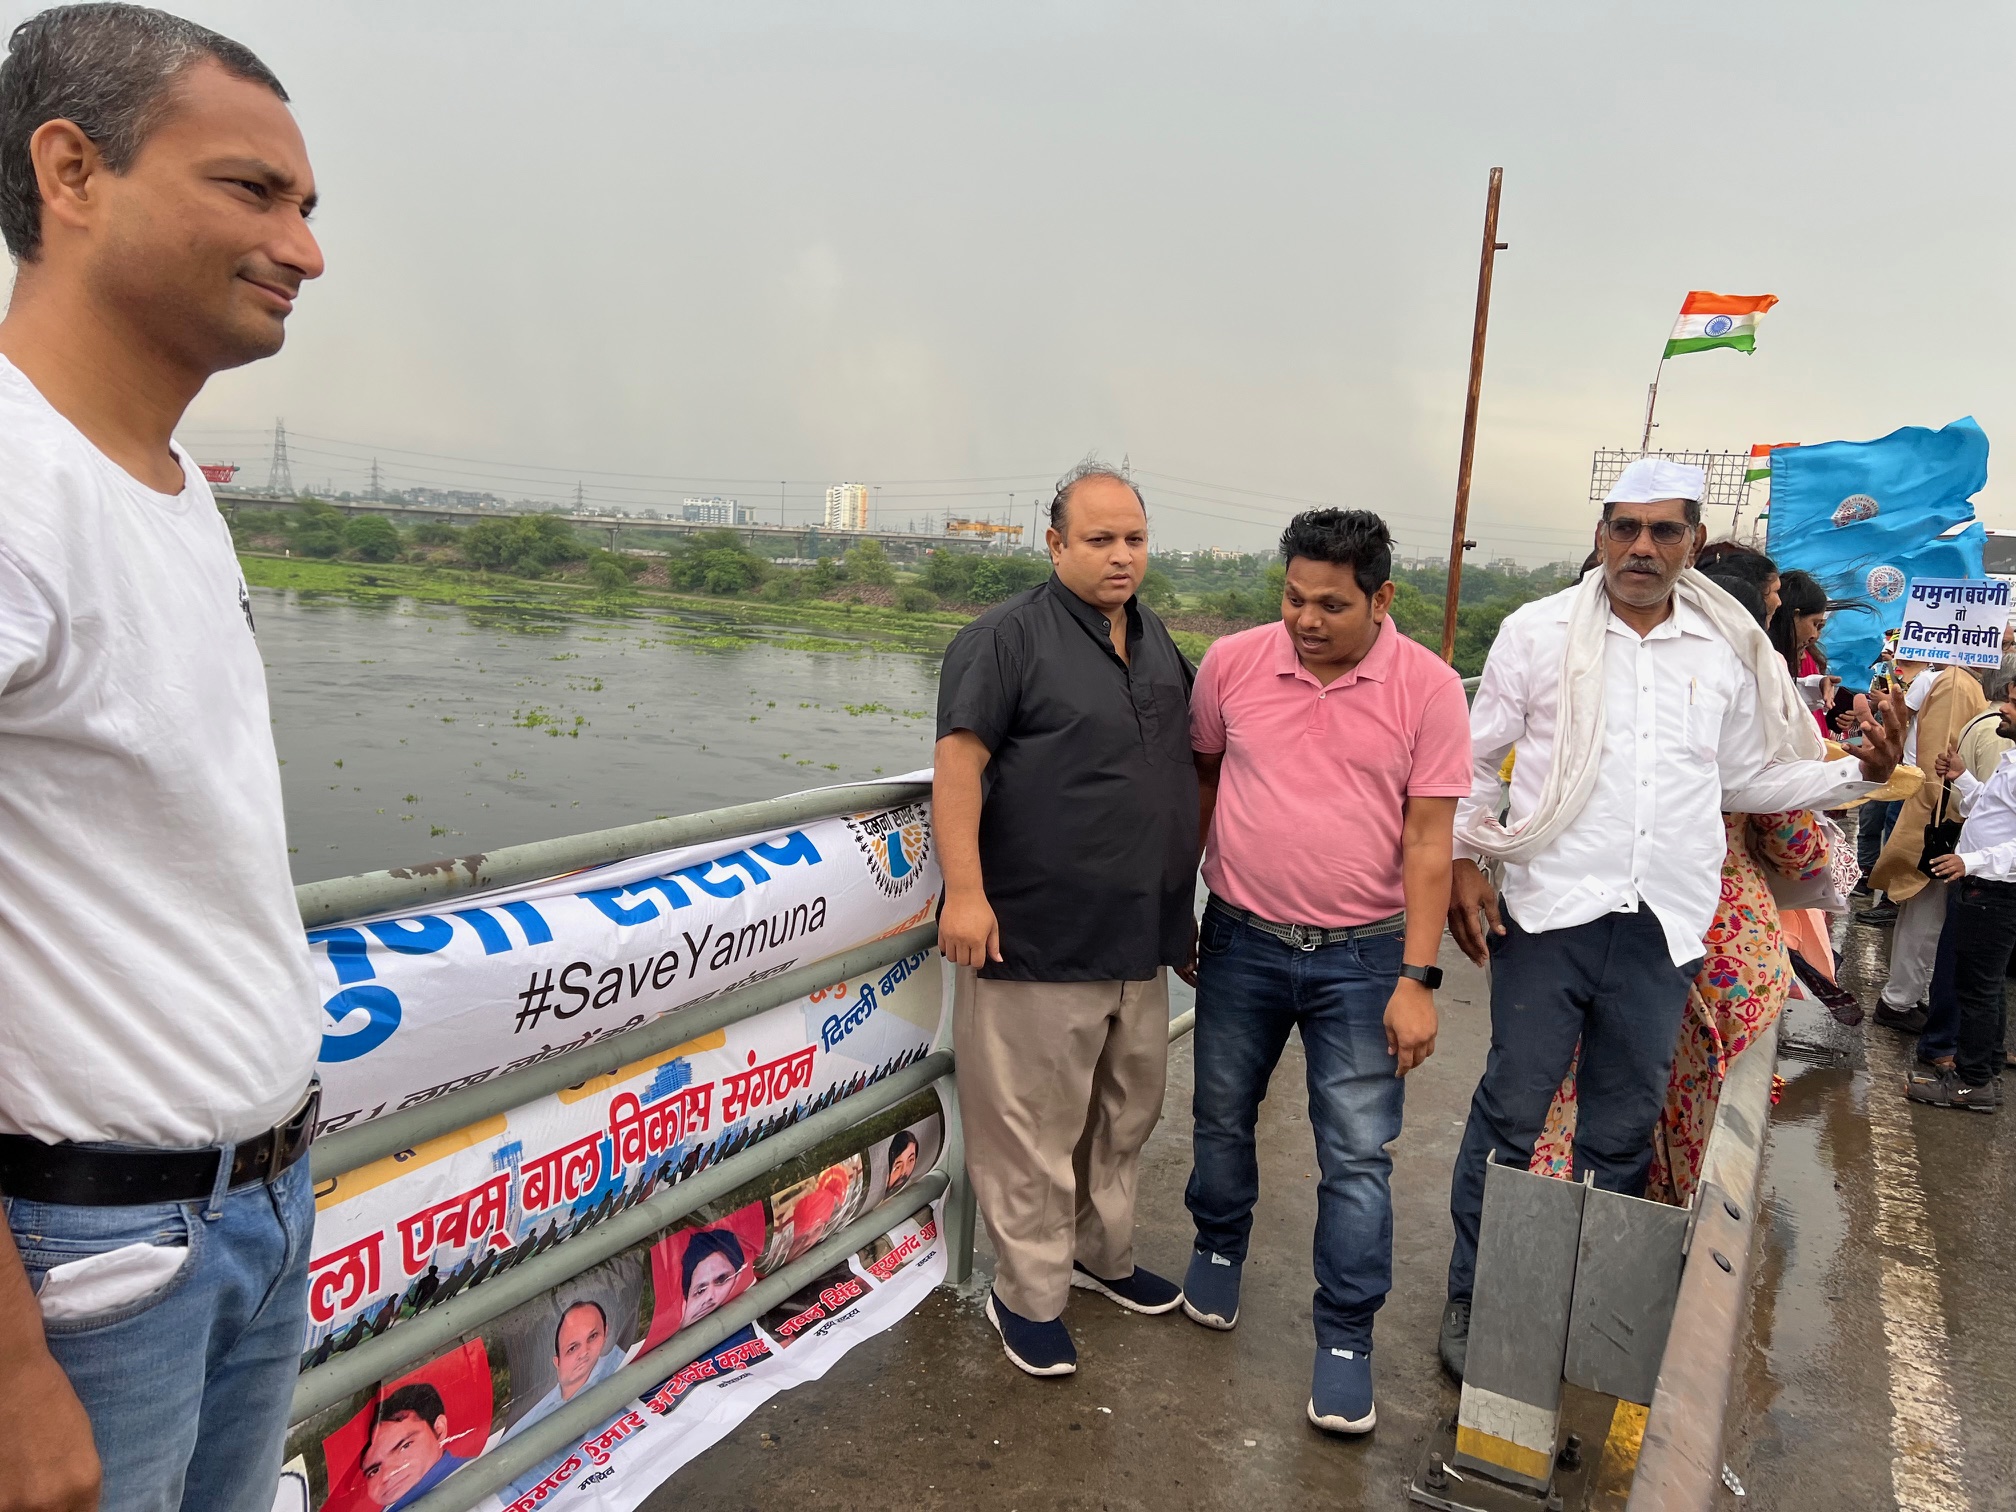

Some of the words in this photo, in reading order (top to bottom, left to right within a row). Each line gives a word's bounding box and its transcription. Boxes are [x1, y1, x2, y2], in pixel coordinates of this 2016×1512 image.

[1912, 585, 1964, 609] यमुना
[1966, 582, 2009, 606] बचेगी
[1955, 606, 1967, 621] तो
[1903, 621, 1960, 645] दिल्ली
[1962, 625, 2001, 648] बचेगी
[1900, 646, 1926, 658] यमुना
[1928, 647, 1950, 659] संसद
[1964, 653, 1976, 664] जून
[1977, 655, 1999, 664] 2023
[513, 896, 827, 1034] #SaveYamuna
[821, 983, 878, 1054] दिल्ली
[397, 1173, 511, 1276] एवम्
[520, 1131, 602, 1211] बाल
[609, 1092, 714, 1175] विकास
[722, 1050, 817, 1123] संगठन
[866, 1234, 921, 1280] सुखानंद
[775, 1303, 826, 1336] नवल
[819, 1280, 863, 1311] सिंह
[716, 1338, 770, 1370] कुमार
